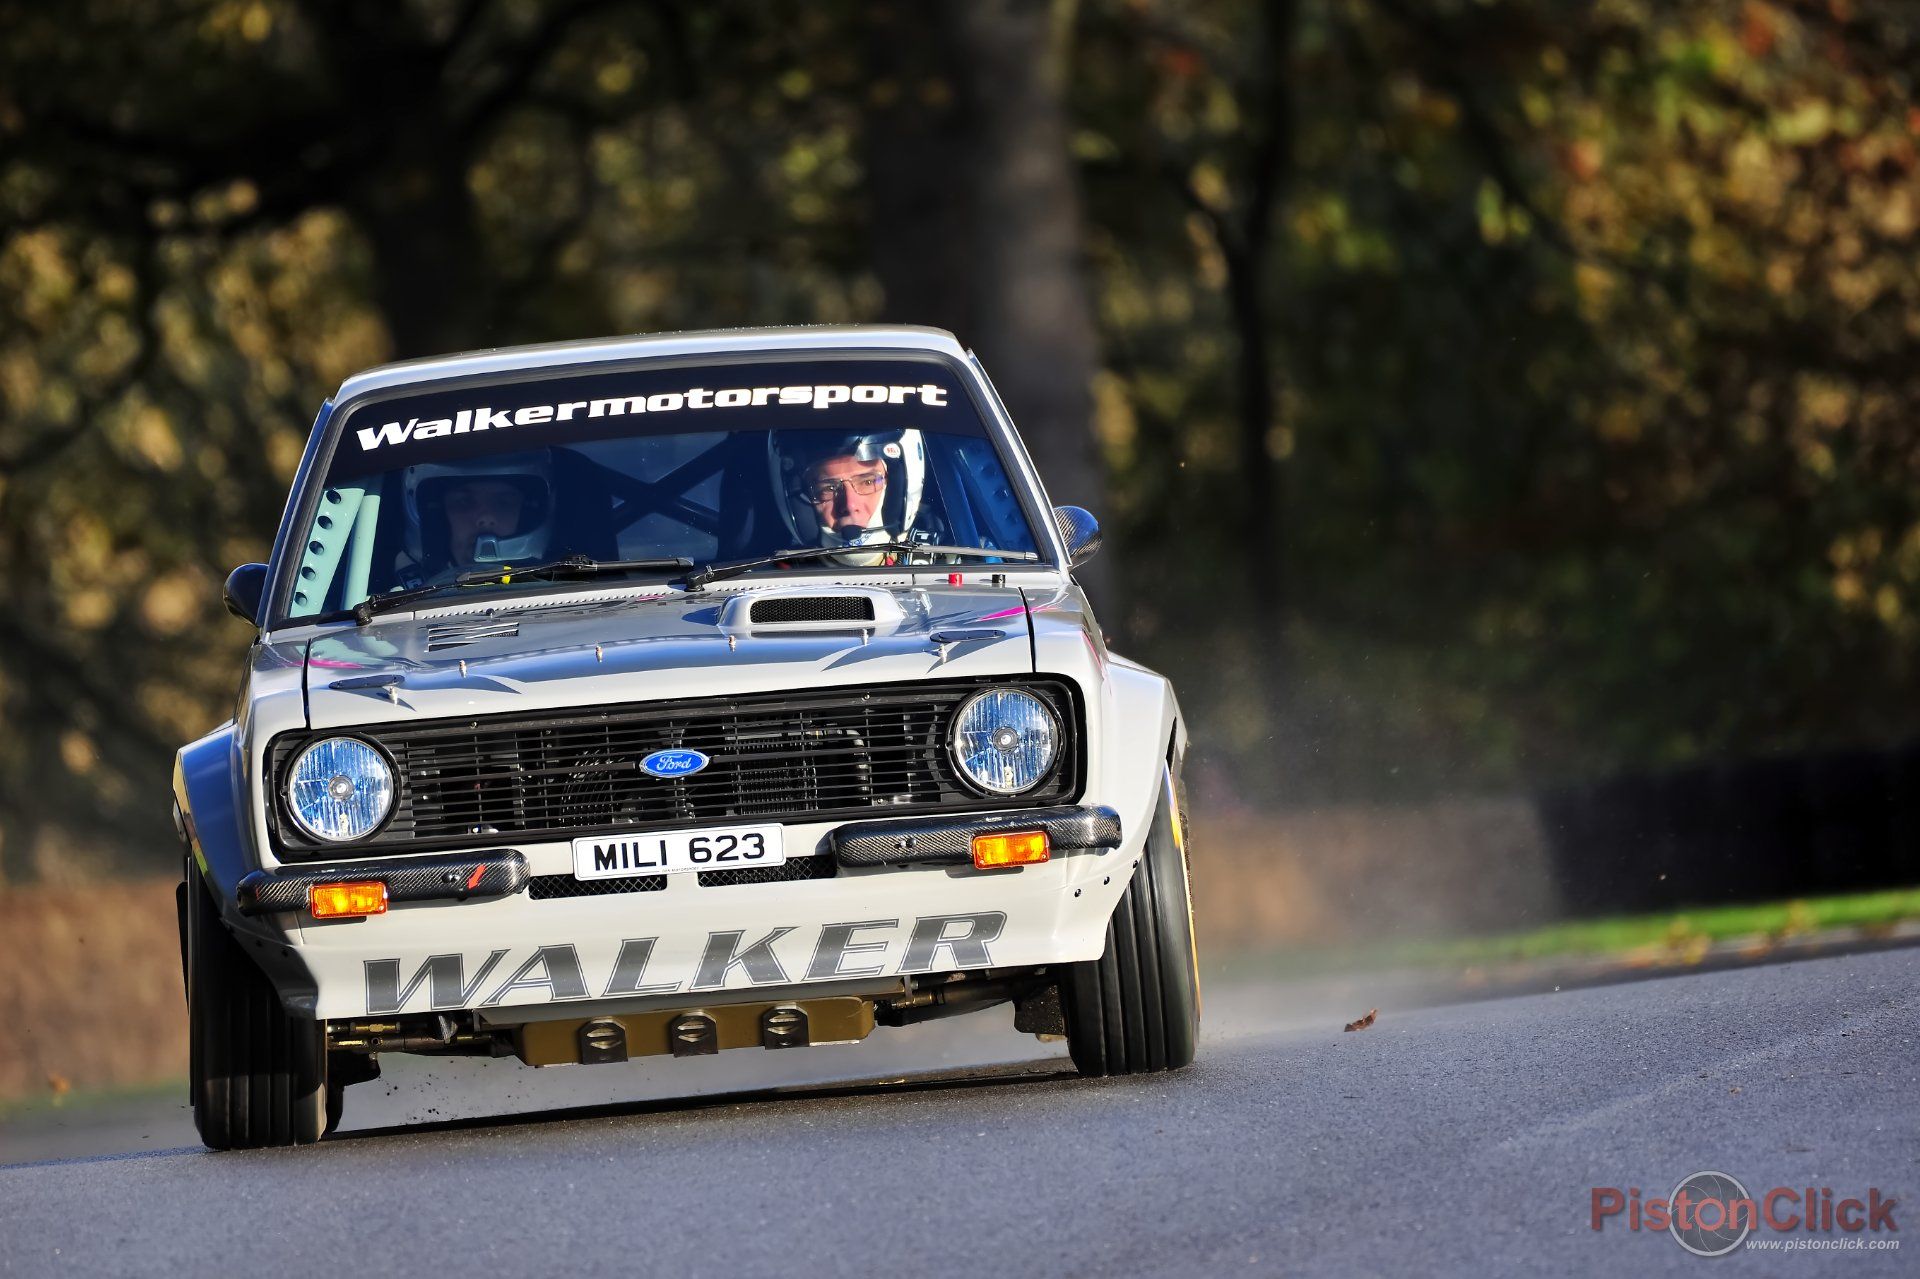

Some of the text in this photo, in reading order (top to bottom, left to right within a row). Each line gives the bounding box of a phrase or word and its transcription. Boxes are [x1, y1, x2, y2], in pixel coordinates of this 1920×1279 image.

[355, 384, 948, 451] Walkermotorsport
[656, 754, 692, 771] Ford
[593, 832, 765, 872] MILI 623
[363, 911, 1006, 1015] WALKER
